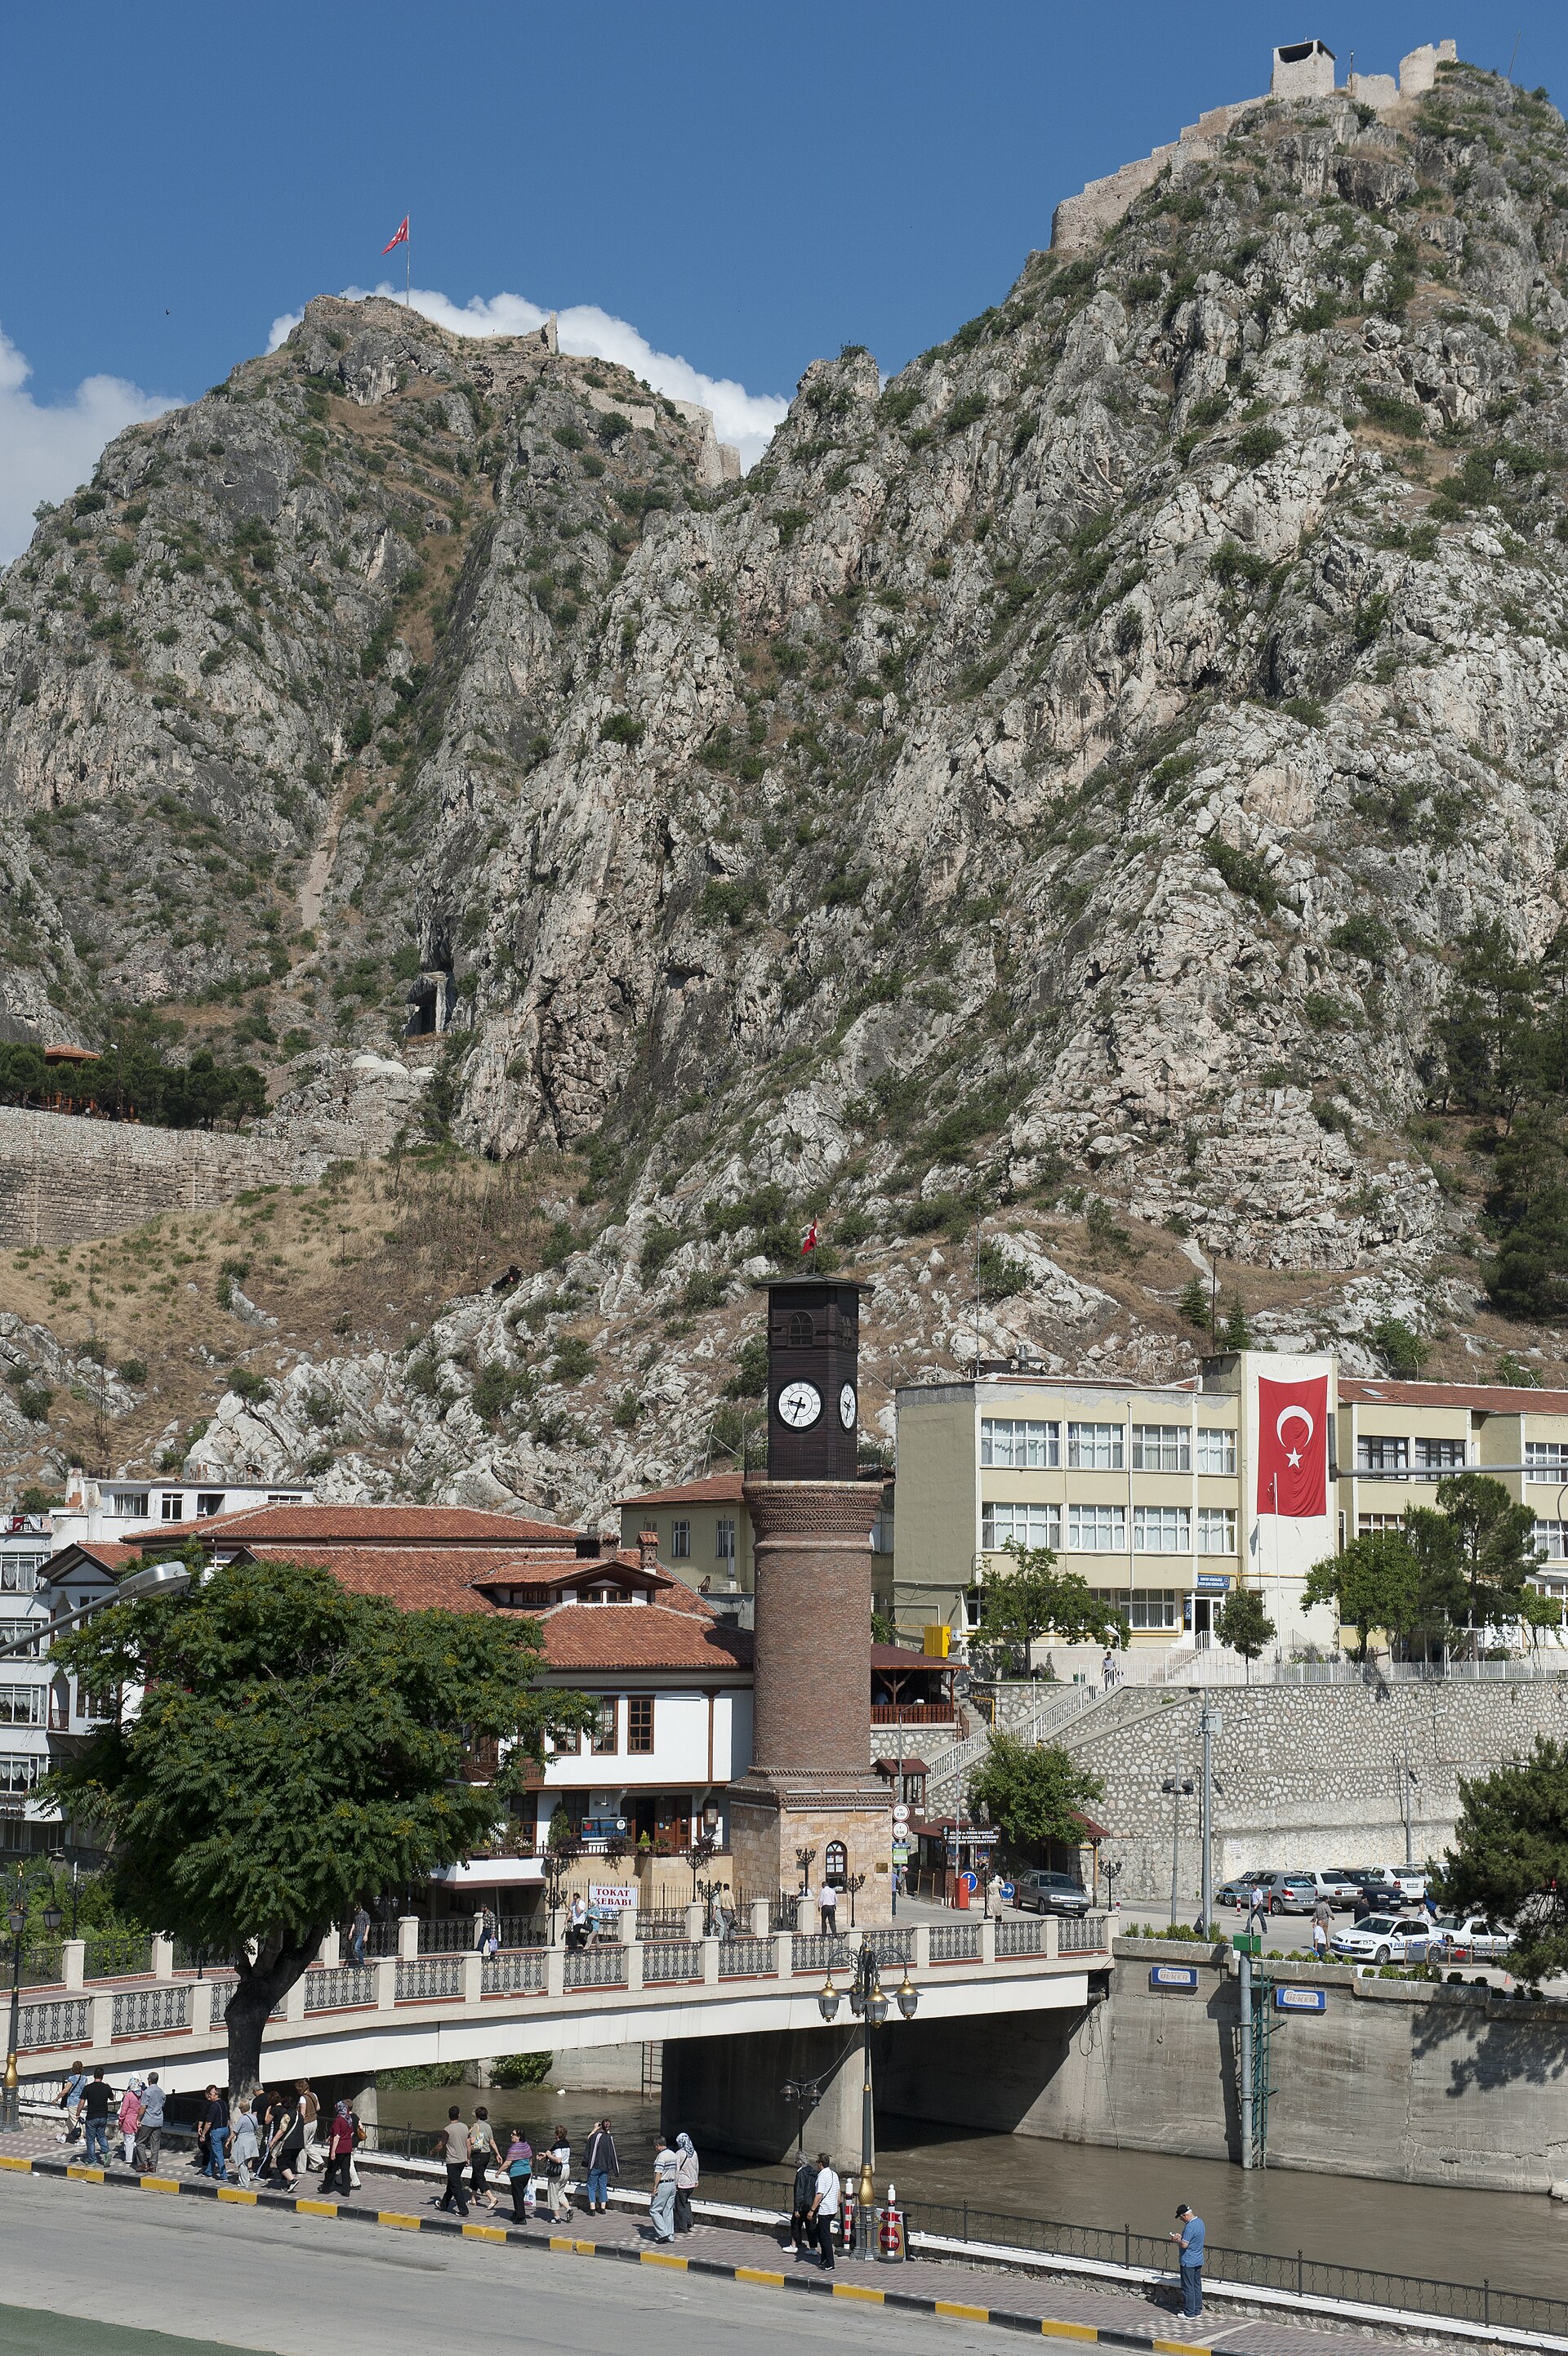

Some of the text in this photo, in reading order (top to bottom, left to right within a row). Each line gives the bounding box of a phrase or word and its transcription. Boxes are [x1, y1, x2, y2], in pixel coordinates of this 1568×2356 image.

[596, 1888, 630, 1896] TOKAT
[1160, 1971, 1188, 1980] ÜLKER
[1286, 1993, 1316, 2003] ÜLKER
